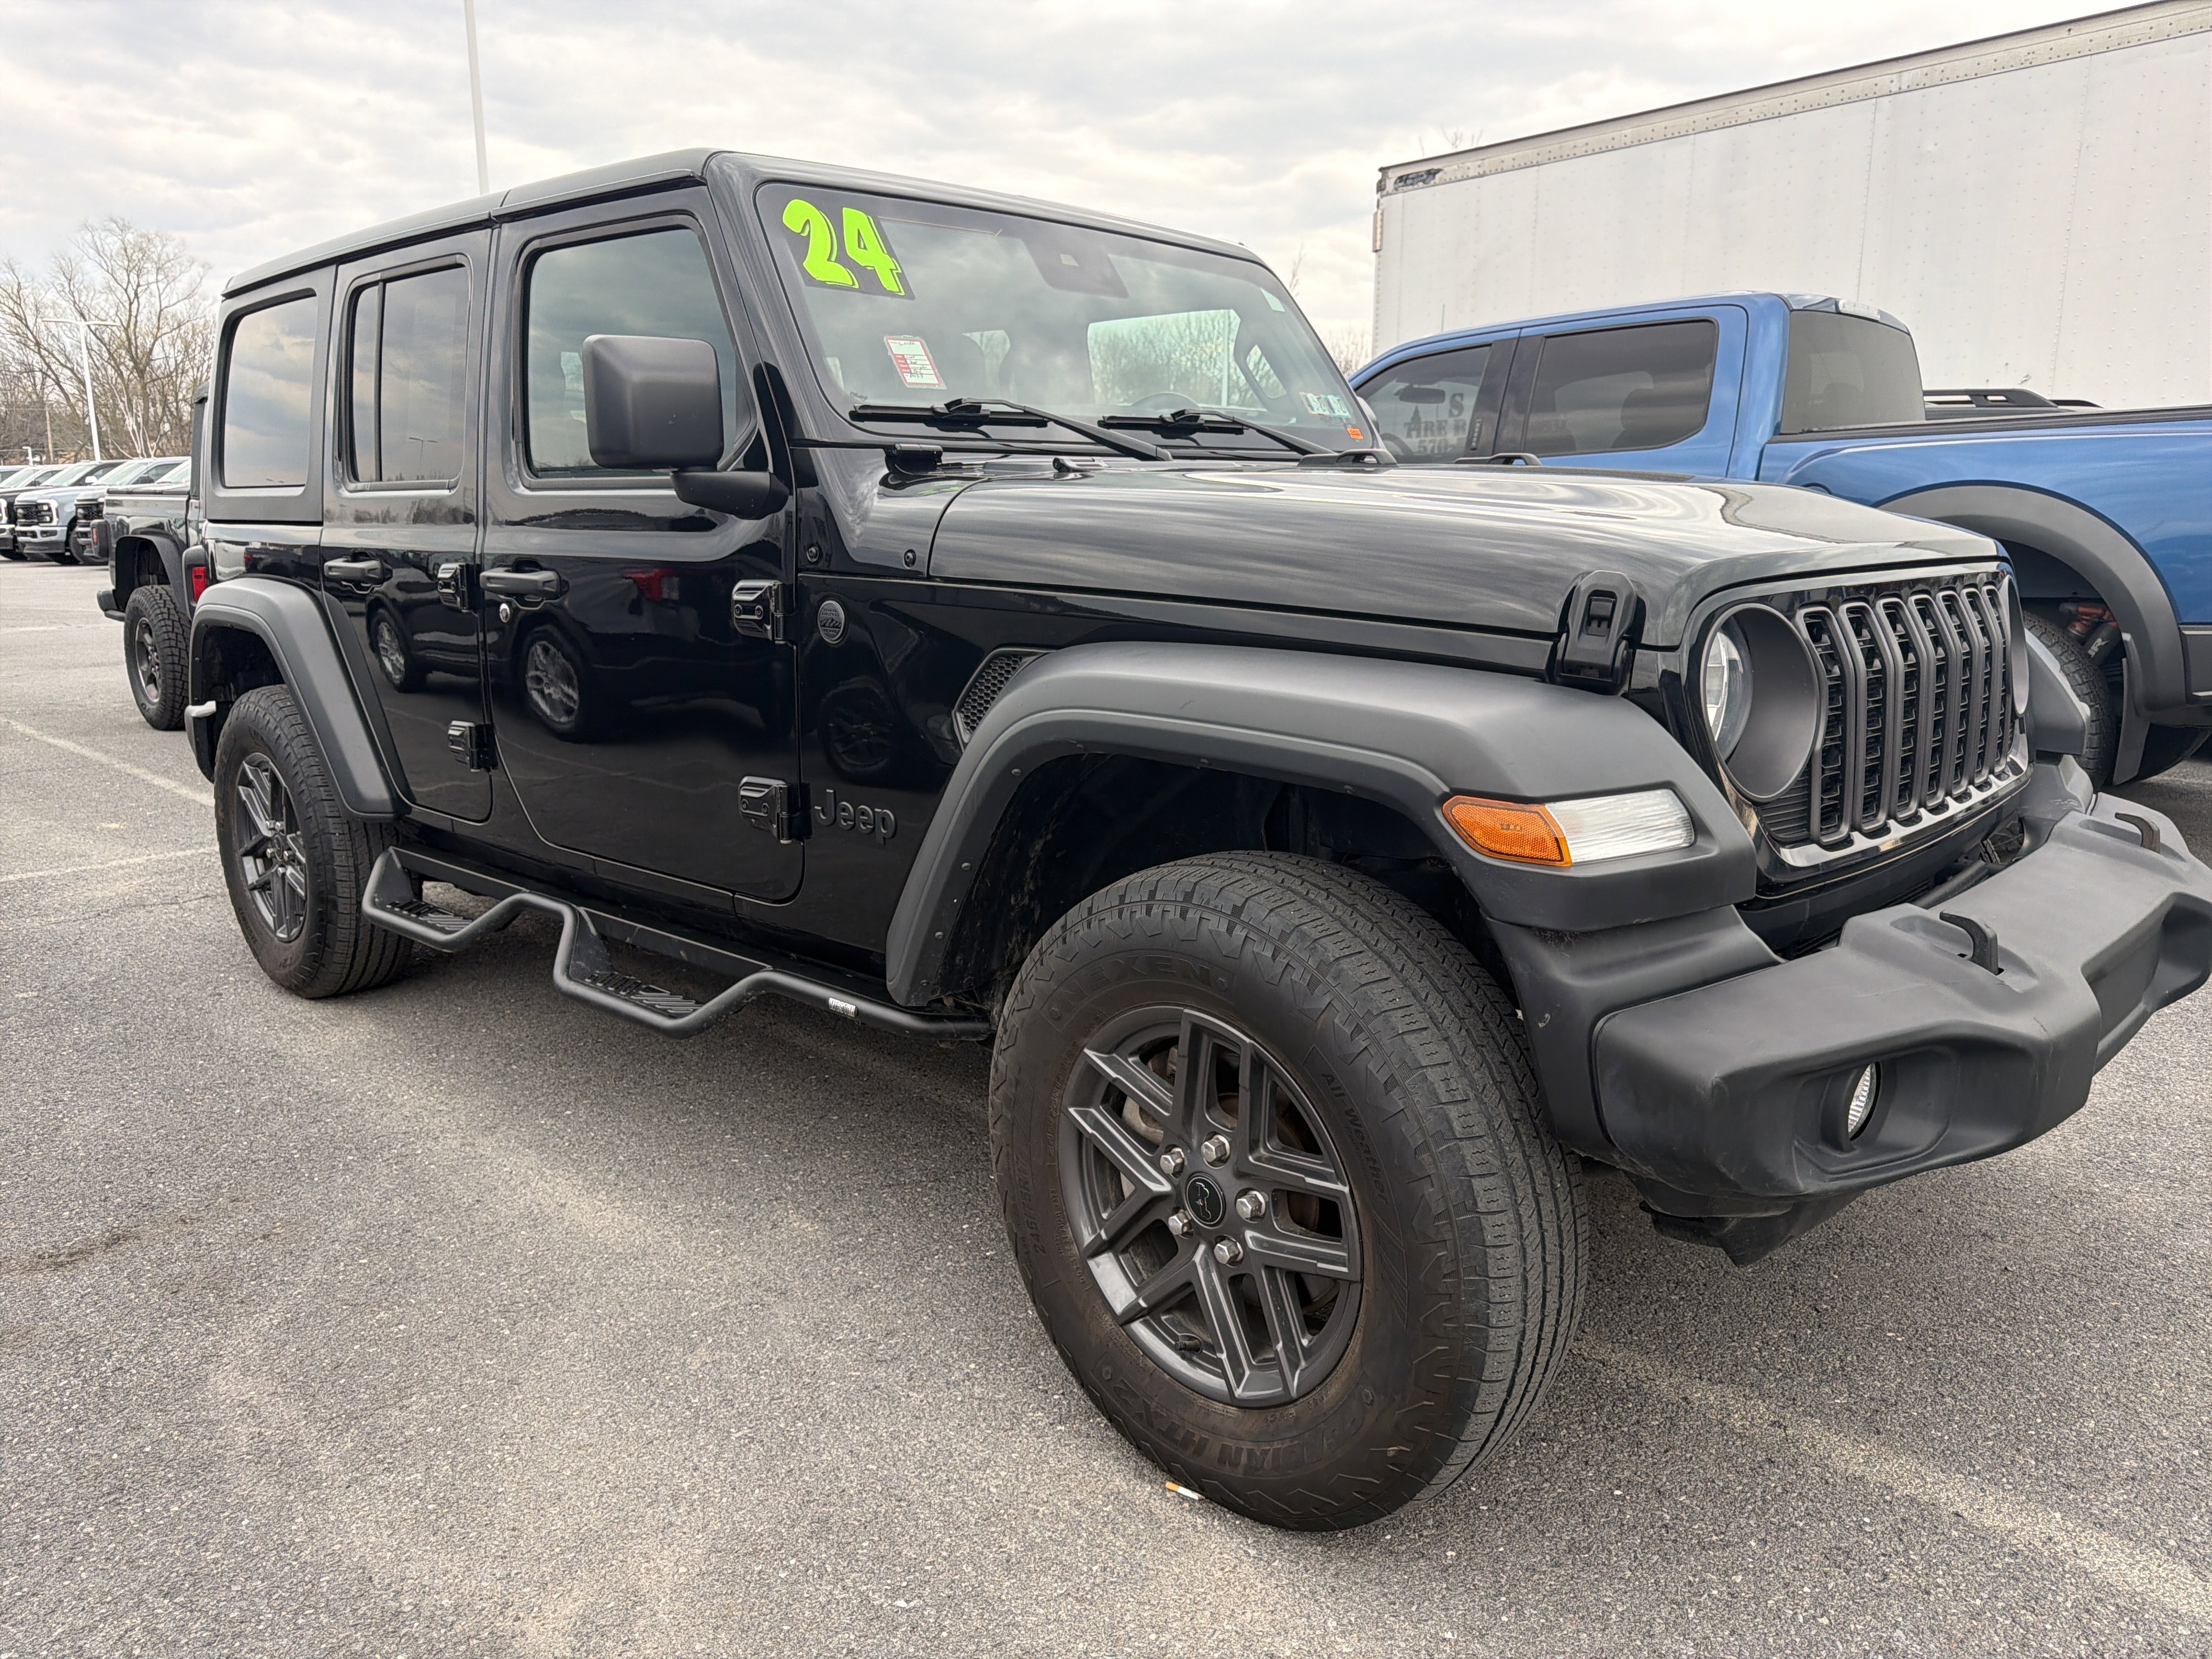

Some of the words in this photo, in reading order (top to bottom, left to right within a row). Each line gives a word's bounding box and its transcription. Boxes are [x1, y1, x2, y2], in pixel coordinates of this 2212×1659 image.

[782, 198, 905, 296] 24
[815, 789, 897, 845] Jeep
[1068, 953, 1212, 1006] NEXEN
[1321, 1074, 1389, 1205] All-Weather
